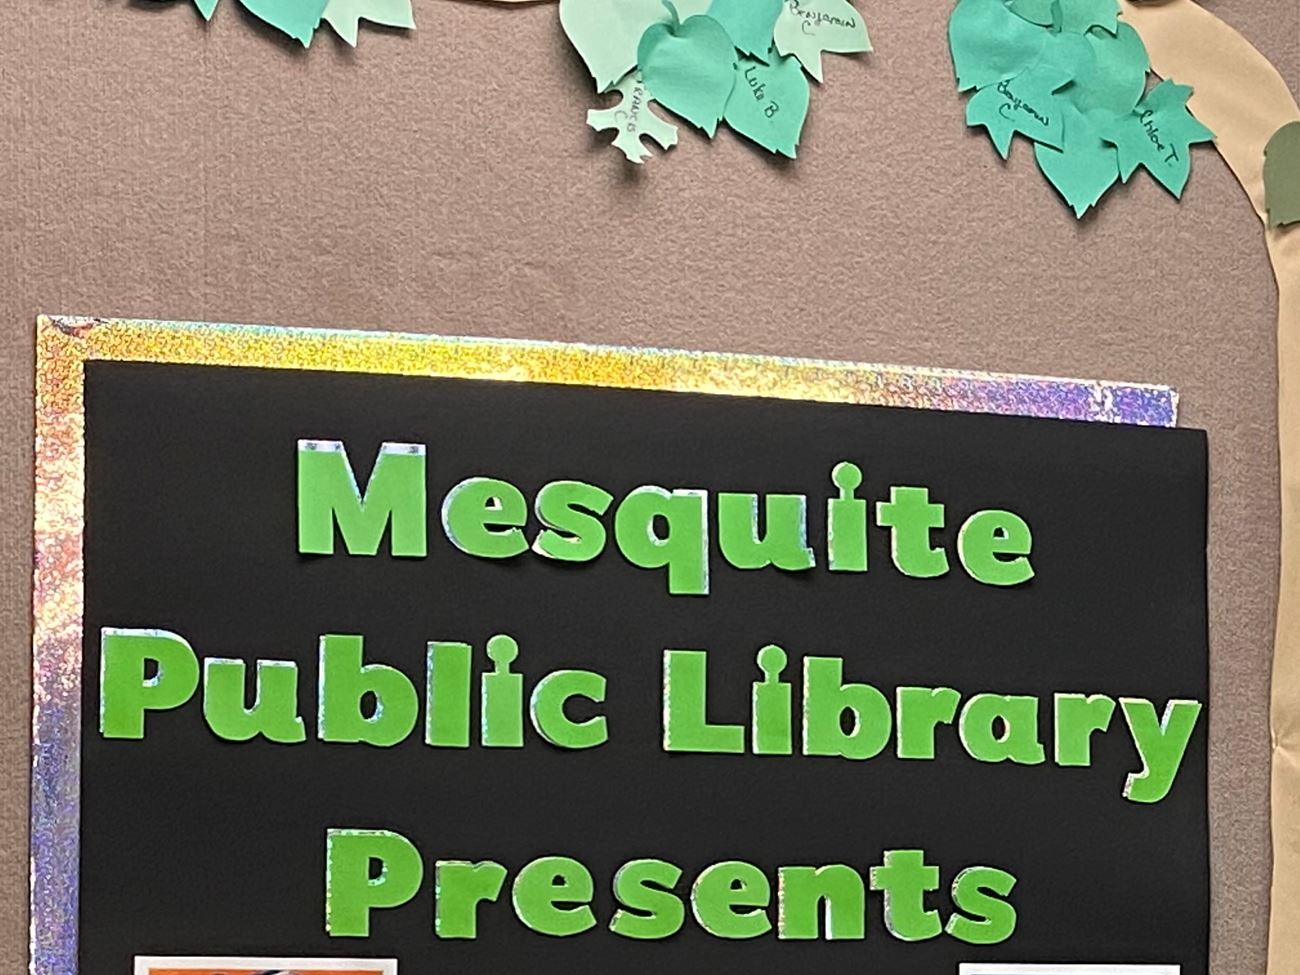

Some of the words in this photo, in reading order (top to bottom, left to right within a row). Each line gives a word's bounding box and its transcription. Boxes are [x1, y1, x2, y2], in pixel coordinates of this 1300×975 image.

[297, 439, 1035, 596] Mesquite
[98, 627, 609, 748] Public
[663, 643, 1202, 803] Library
[325, 828, 1018, 944] Presents
